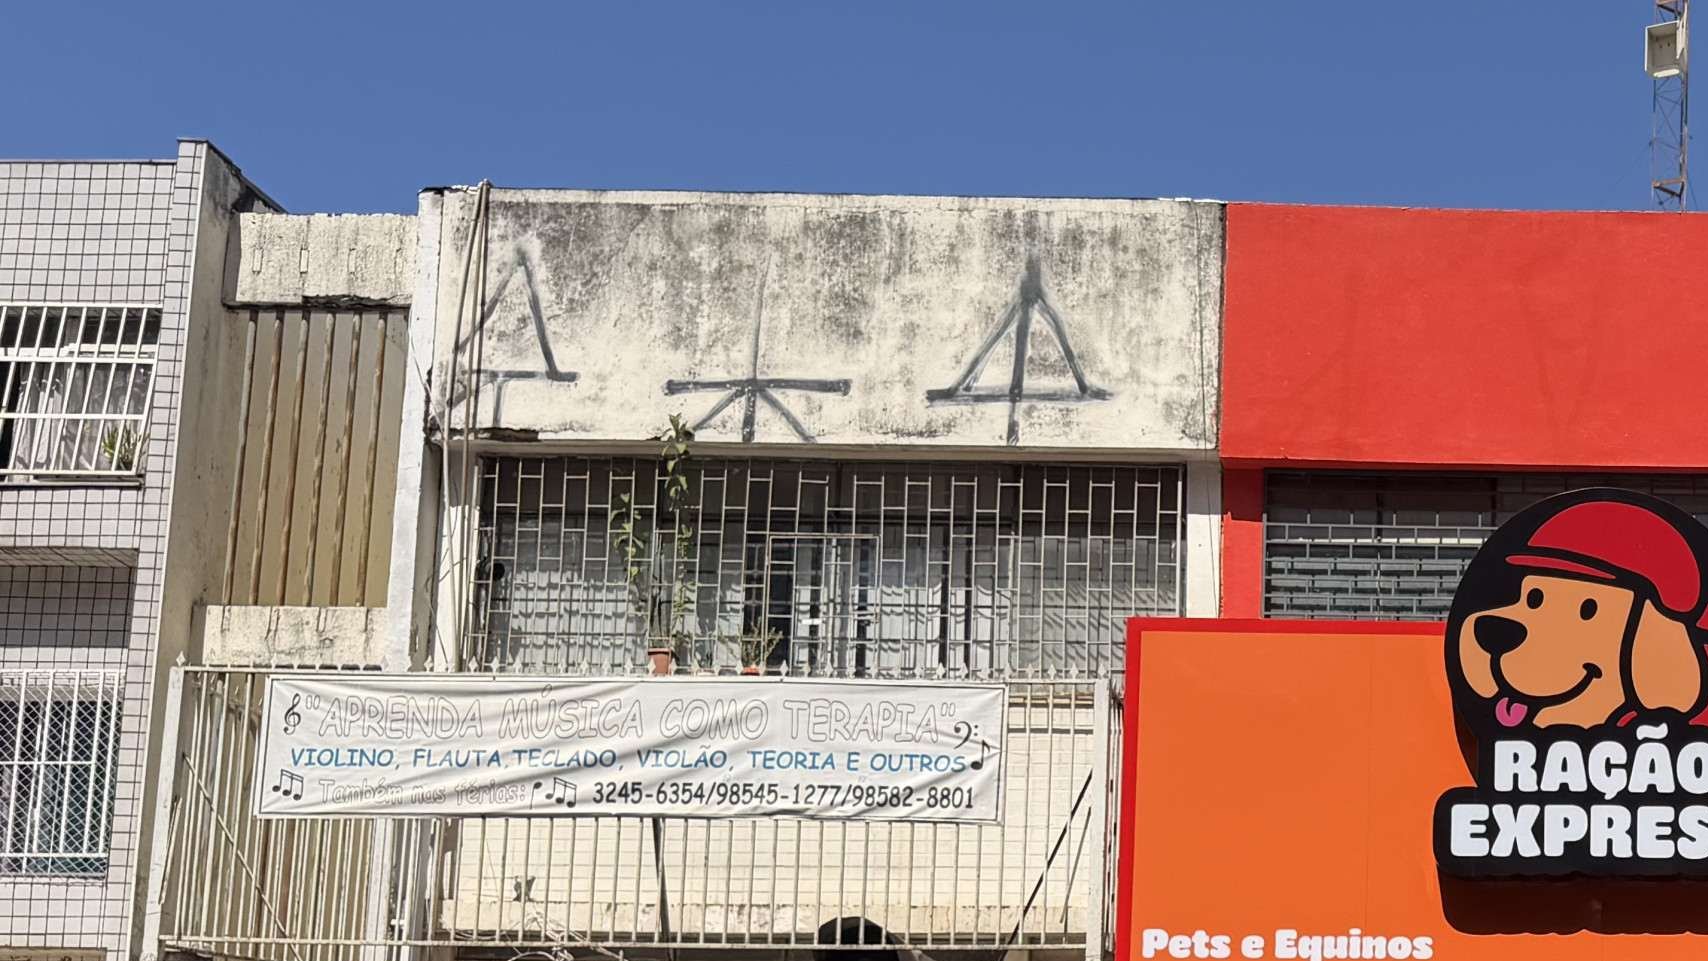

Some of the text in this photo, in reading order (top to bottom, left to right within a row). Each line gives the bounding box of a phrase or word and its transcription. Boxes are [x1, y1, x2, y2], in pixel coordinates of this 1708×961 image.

[500, 683, 643, 740] MÚSICA
[660, 698, 769, 741] COMO
[290, 747, 400, 770] VIOLINO,
[509, 747, 624, 771] TECLADO,
[636, 744, 735, 772] VIOLÃO,
[751, 750, 836, 771] TEORIA
[870, 752, 967, 773] OUTROS
[318, 777, 404, 805] Também
[410, 784, 448, 805] nas
[1142, 928, 1231, 959] Pets
